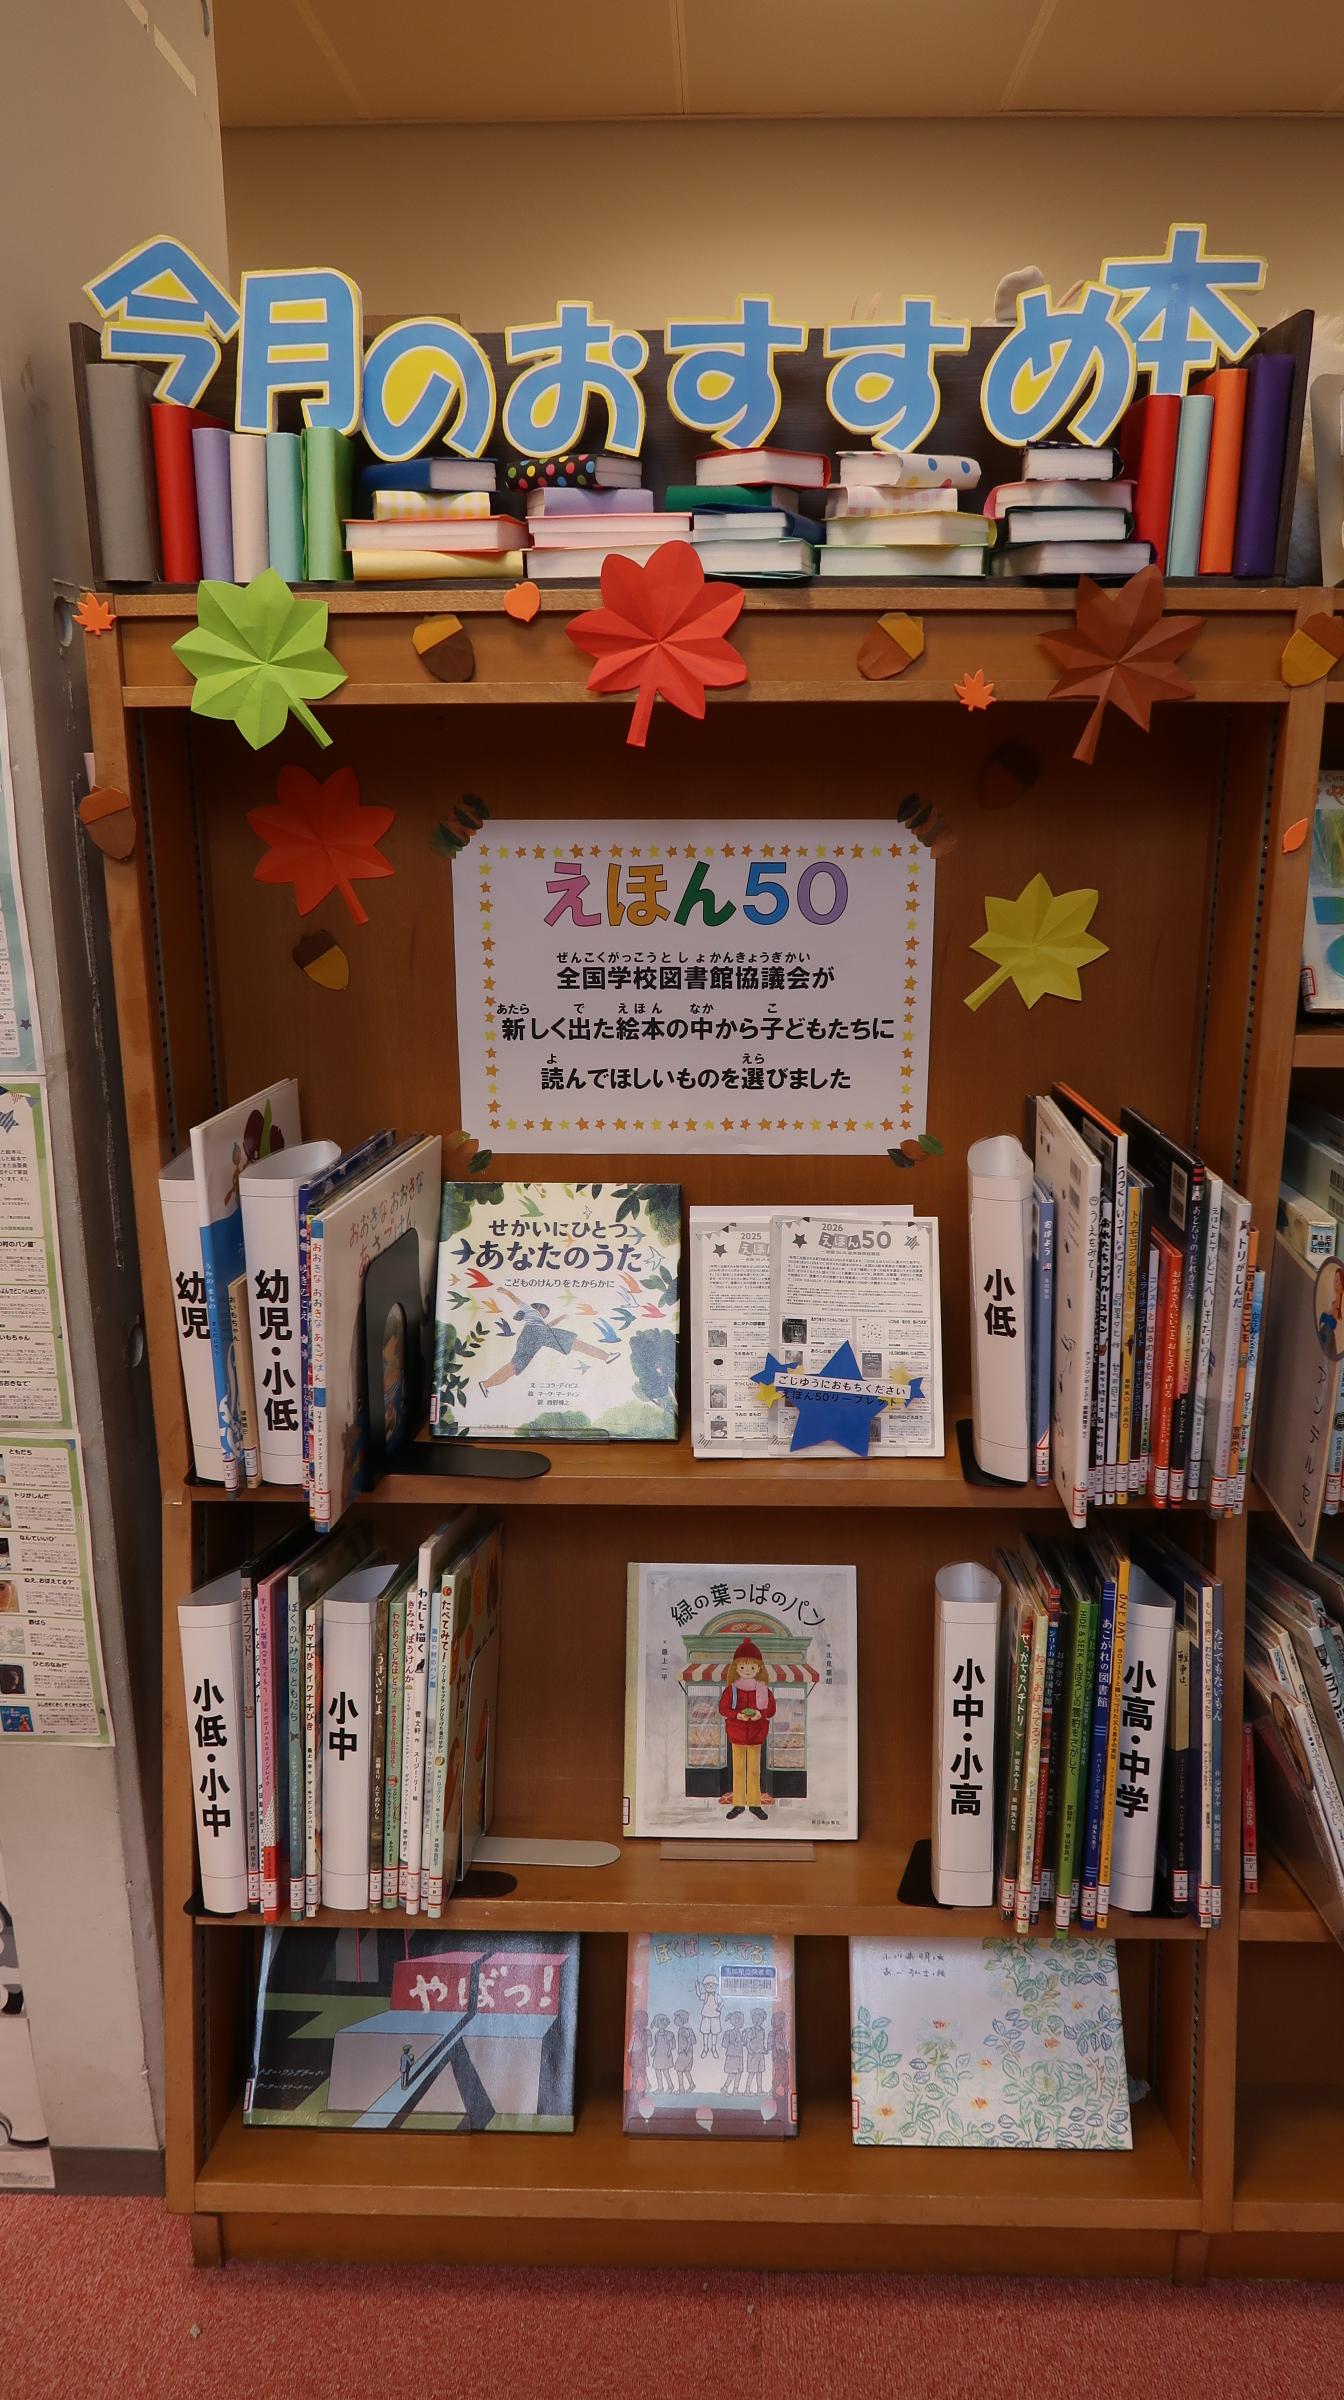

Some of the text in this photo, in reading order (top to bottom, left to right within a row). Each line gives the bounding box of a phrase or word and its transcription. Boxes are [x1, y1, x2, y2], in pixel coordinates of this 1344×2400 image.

[82, 223, 1268, 460] 今月のおすすめ本
[543, 861, 848, 927] えほん50
[556, 966, 835, 990] 全国学校図書館協議会が
[497, 1003, 778, 1015] あたら で えほん なか こ
[502, 1017, 895, 1041] 新しく出た絵本の中から子どもたちに
[541, 1067, 852, 1091] 読んでほしいものを選びました
[547, 1054, 765, 1065] よ えら
[488, 1219, 629, 1239] せかいにひとつ
[738, 1241, 770, 1256] えほ
[740, 1232, 762, 1240] 2025
[818, 1231, 892, 1250] えほん50
[821, 1223, 844, 1232] 2026
[475, 1240, 642, 1273] あなたのうた
[1232, 1238, 1250, 1309] トリがしんだ
[176, 1270, 210, 1341] 幼児
[504, 1278, 615, 1289] こどものけんりをたからかに
[984, 1269, 1017, 1339] 小低
[255, 1268, 299, 1432] 幼児・小低
[778, 1375, 907, 1396] ごじゆうにおもちください
[415, 1588, 428, 1653] わたしを描く
[671, 1583, 826, 1628] 緑の葉っぱのパン
[1116, 1593, 1128, 1642] ONE DAY
[440, 1600, 452, 1663] たべてみて！
[289, 1602, 300, 1722] ぼくのひみつのともだち
[1017, 1633, 1031, 1727] せっかちなハチドリ
[1097, 1618, 1113, 1708] あこがれの図書館
[328, 1691, 359, 1761] 小中
[950, 1658, 985, 1817] 小中・小高
[1114, 1661, 1157, 1820] 小高・中学
[192, 1678, 232, 1838] 小低・小中
[409, 1965, 554, 2014] やばっ！
